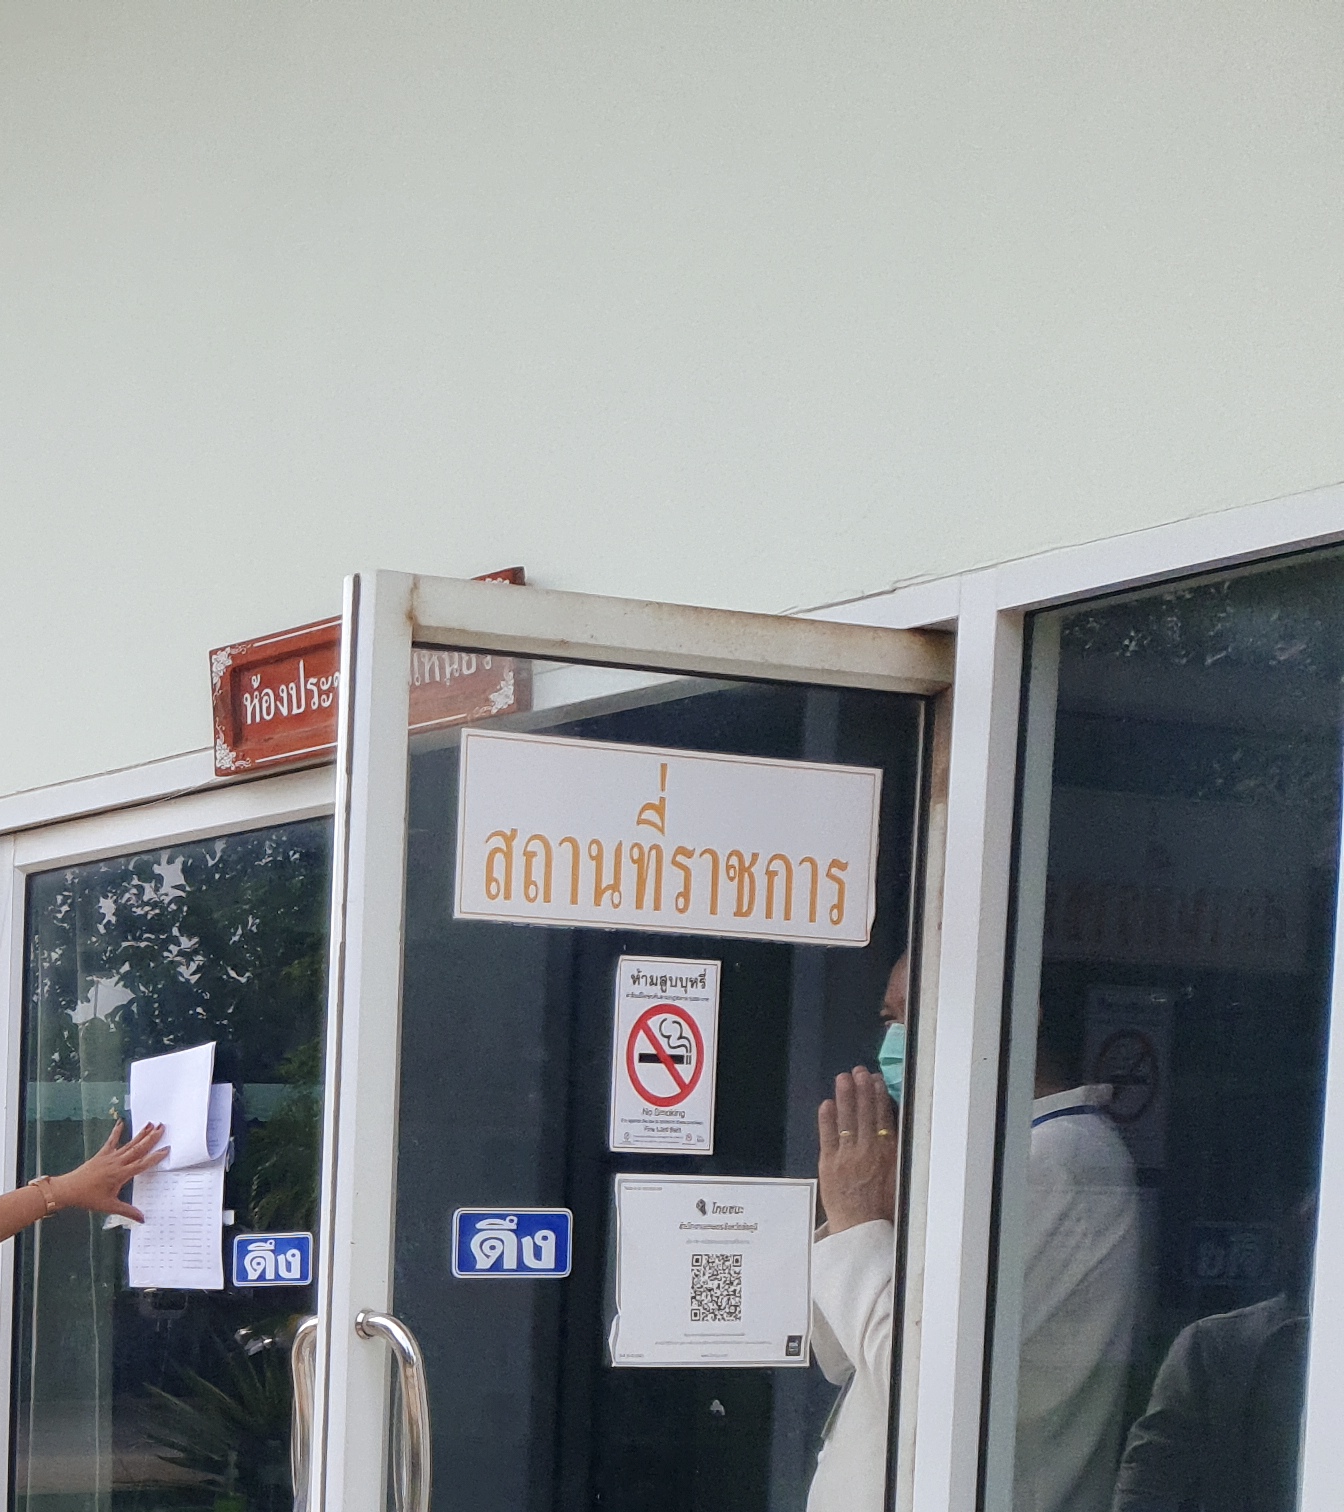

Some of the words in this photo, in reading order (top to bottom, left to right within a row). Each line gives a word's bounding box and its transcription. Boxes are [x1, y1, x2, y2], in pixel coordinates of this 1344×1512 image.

[484, 762, 849, 927] สถานที่ราชการ
[630, 968, 707, 994] ห้ามสูบบุหรี่
[243, 1239, 302, 1280] ดึง
[470, 1215, 557, 1270] ดึง
